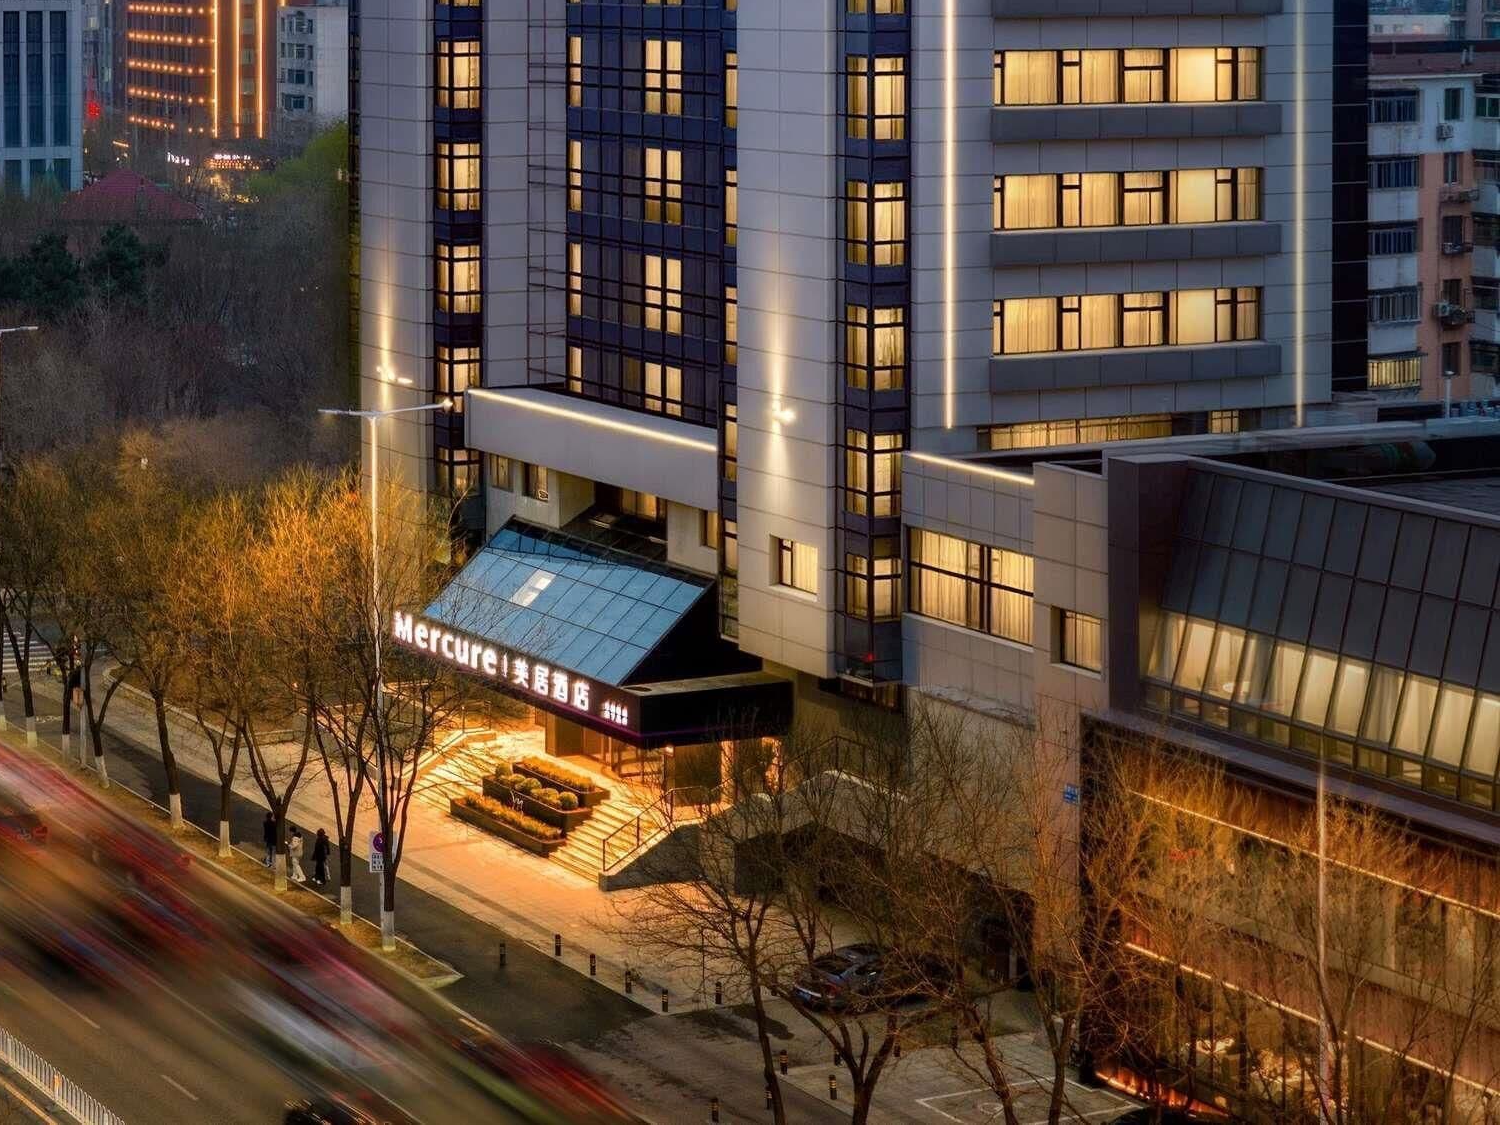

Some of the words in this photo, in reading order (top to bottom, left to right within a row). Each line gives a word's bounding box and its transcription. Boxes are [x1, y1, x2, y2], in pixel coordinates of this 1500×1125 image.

[394, 611, 498, 675] Mercure
[513, 658, 590, 712] 美居酒店
